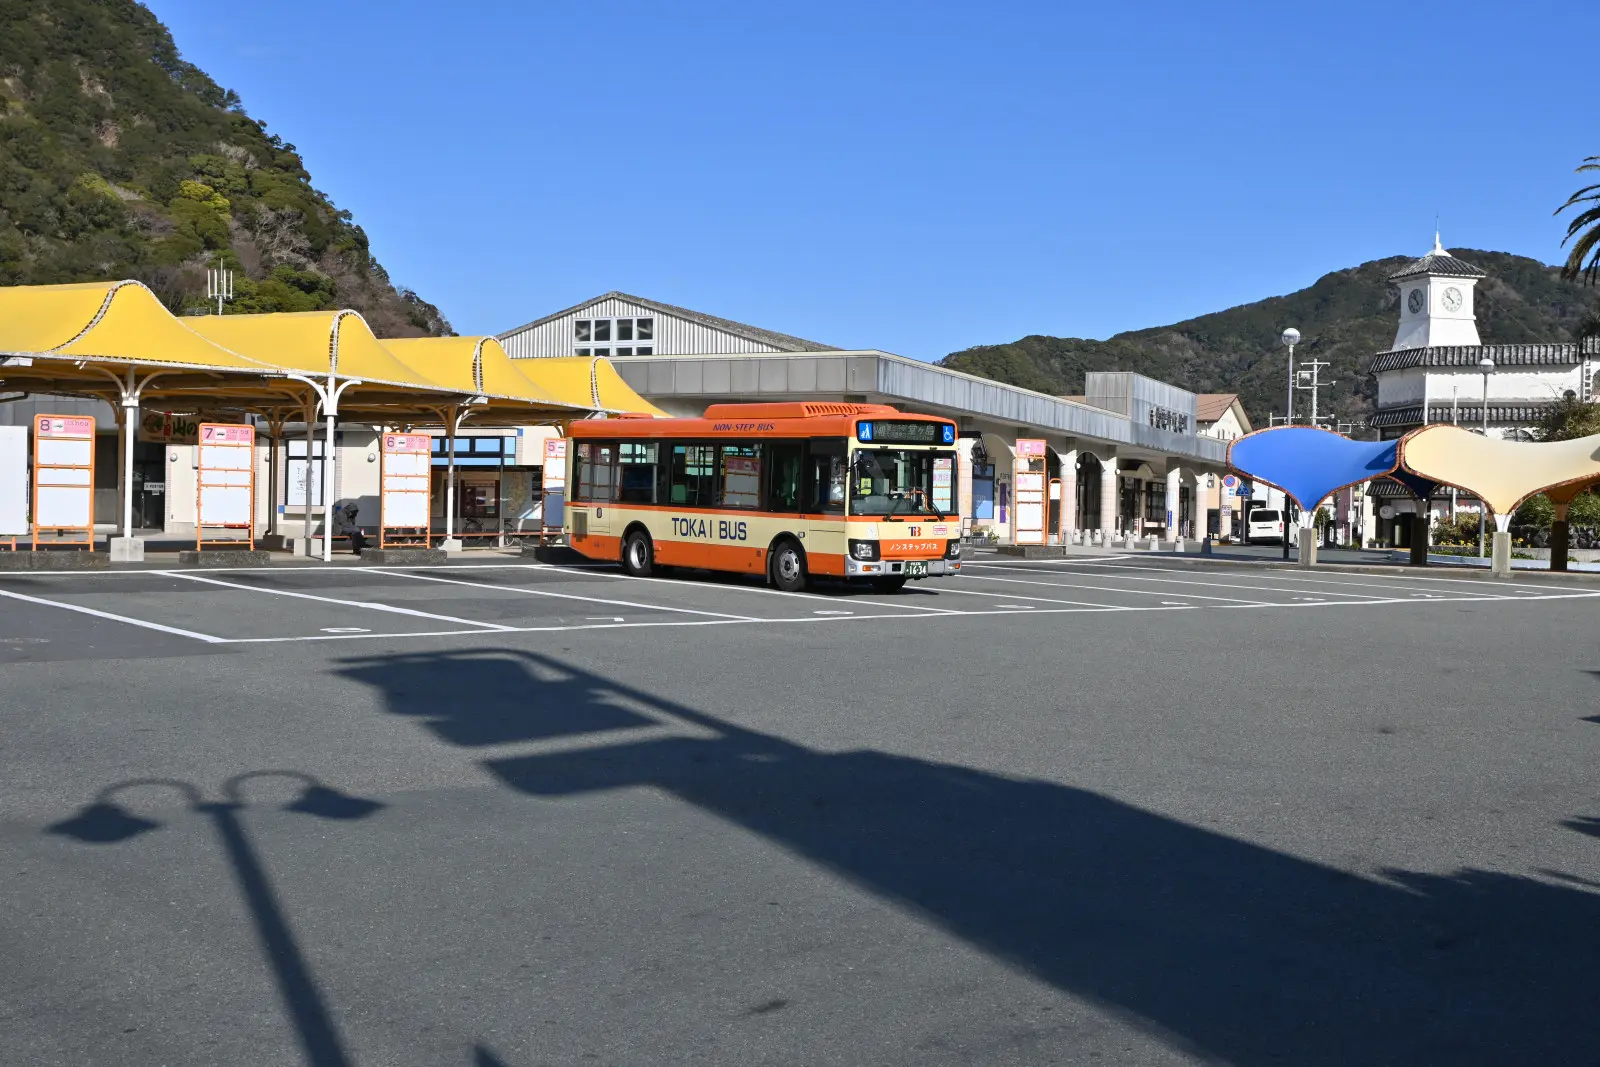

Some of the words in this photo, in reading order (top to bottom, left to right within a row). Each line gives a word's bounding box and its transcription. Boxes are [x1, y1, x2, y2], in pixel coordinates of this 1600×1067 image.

[40, 419, 50, 431] 8
[757, 423, 775, 432] BUS
[204, 427, 213, 439] 7
[387, 436, 395, 447] 6
[548, 441, 555, 452] 5
[671, 517, 713, 538] TOKAI
[719, 520, 748, 541] BUS
[889, 542, 939, 551] ノンステップバス
